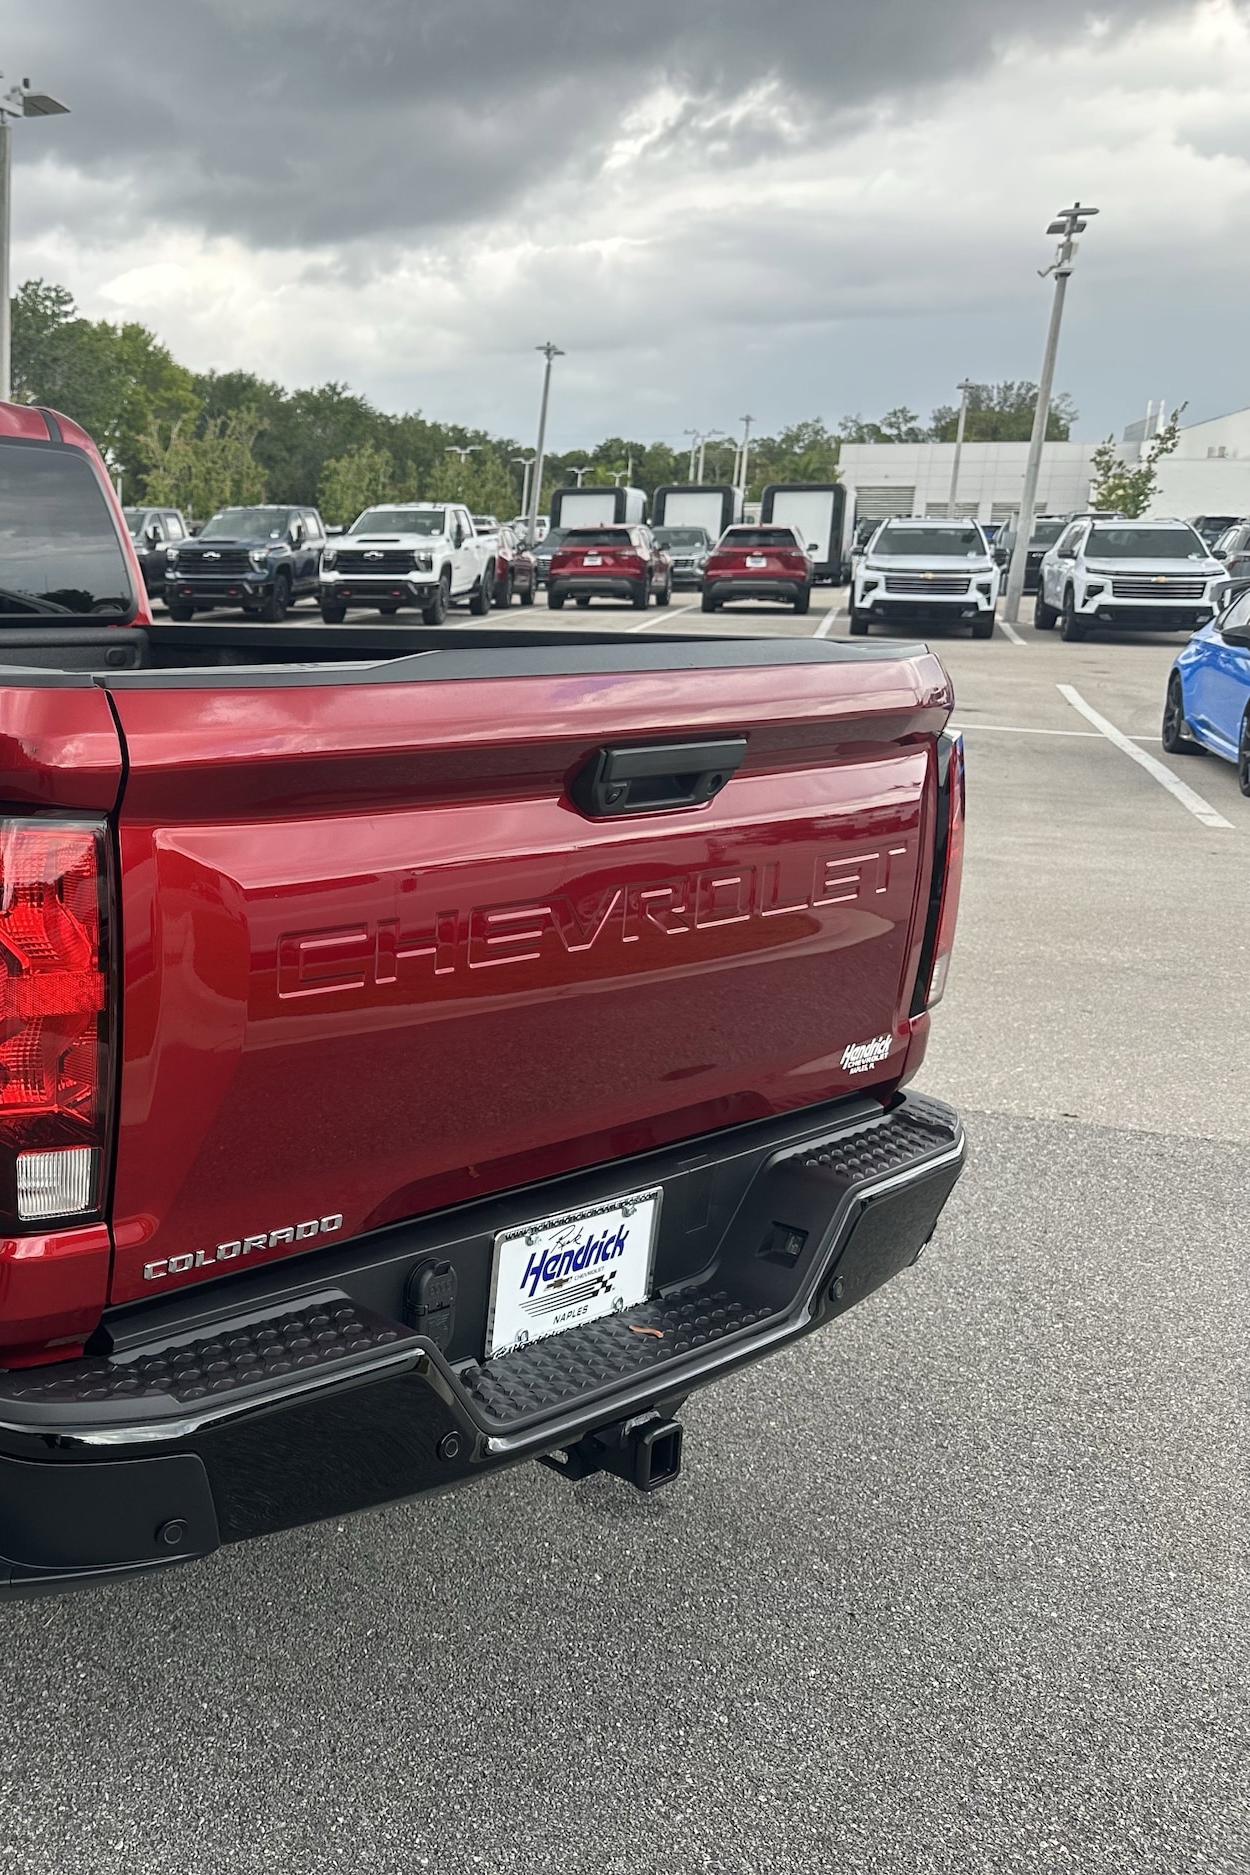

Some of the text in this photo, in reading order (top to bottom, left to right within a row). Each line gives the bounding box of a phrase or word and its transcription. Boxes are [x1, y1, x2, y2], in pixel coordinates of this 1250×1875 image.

[276, 840, 907, 1000] CHEVROLET
[839, 1033, 893, 1070] Hendrick
[847, 1051, 889, 1069] CHEVROLET
[144, 1213, 343, 1280] COLORADO
[519, 1223, 630, 1298] Hendrick
[574, 1265, 605, 1281] CHEVROLET
[552, 1304, 589, 1325] NAPLES
